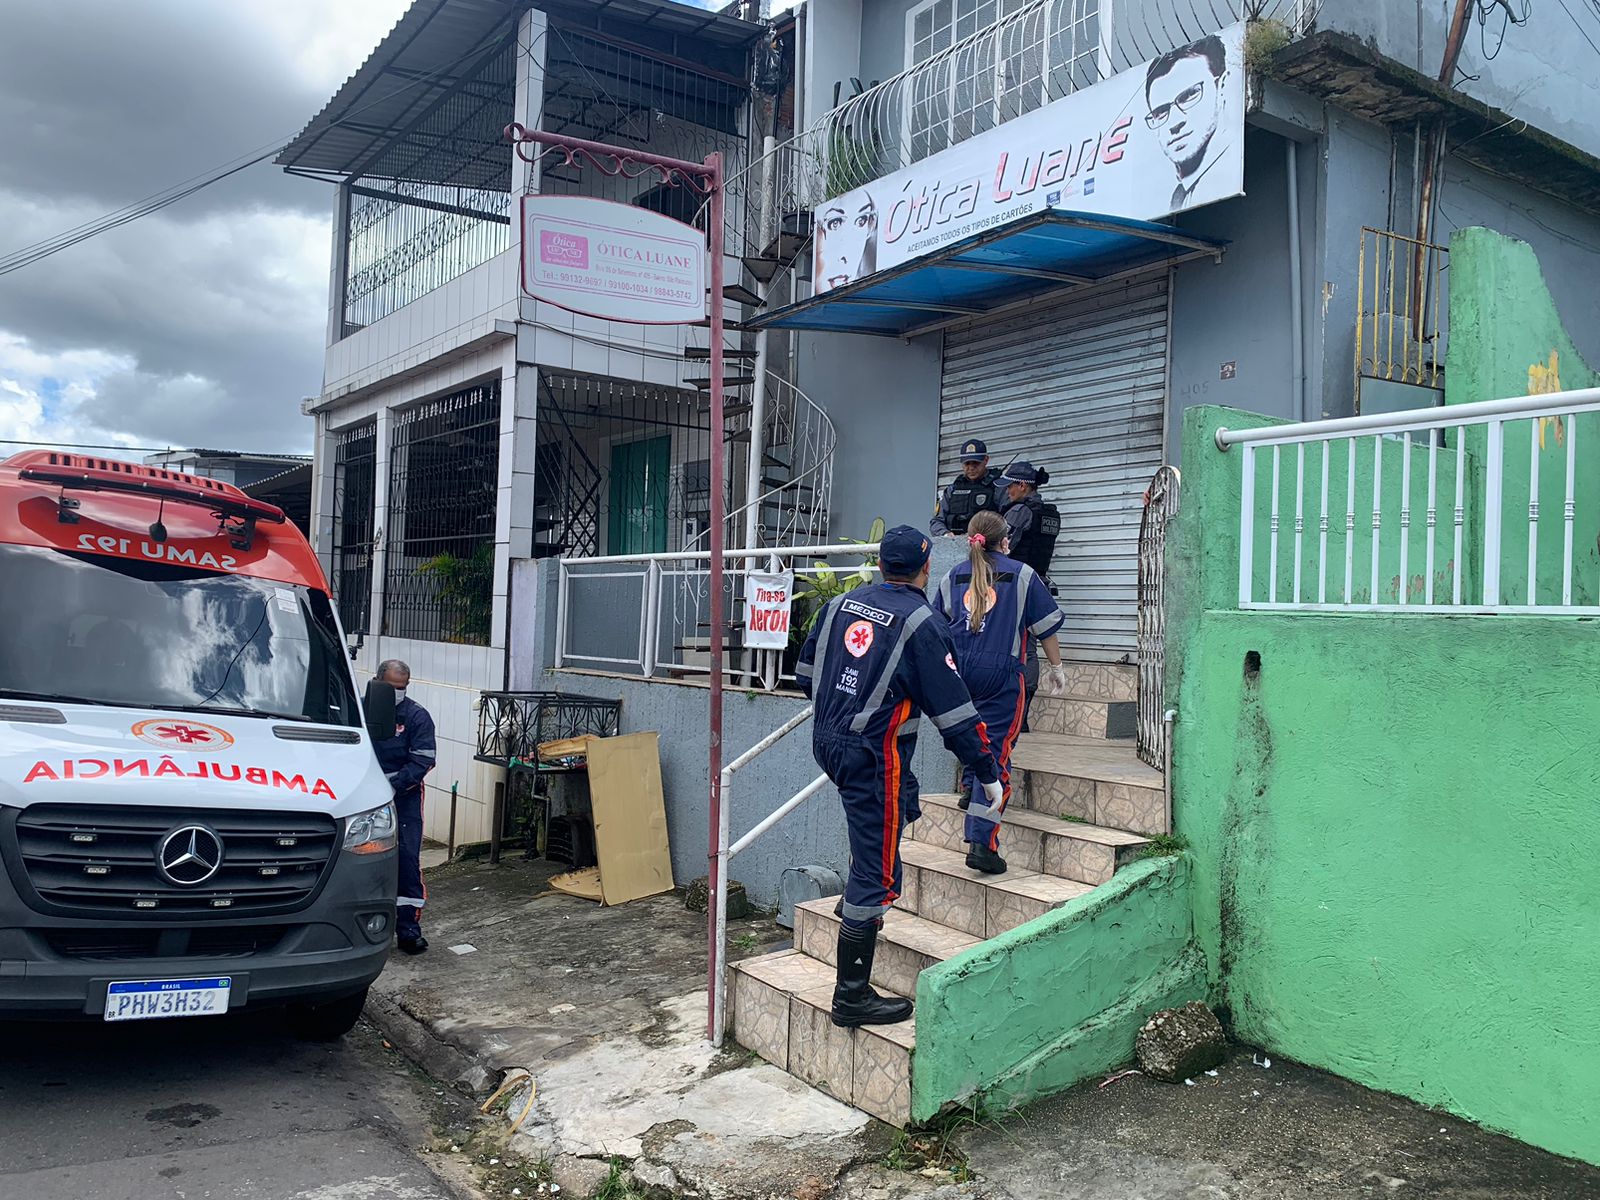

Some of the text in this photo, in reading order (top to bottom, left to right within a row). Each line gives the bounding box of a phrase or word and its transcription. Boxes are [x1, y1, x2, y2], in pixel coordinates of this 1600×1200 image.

[885, 178, 980, 244] Ótica
[907, 202, 1033, 253] ACEITAMOS TODOS OS TIPOS DE CARTÕES
[597, 240, 642, 261] ÓTICA
[646, 251, 691, 268] LUANE
[756, 587, 786, 602] Tira-se
[749, 604, 789, 632] Xerox
[965, 619, 986, 632] 12
[840, 673, 857, 688] 192
[118, 991, 216, 1016] PHW3H32
